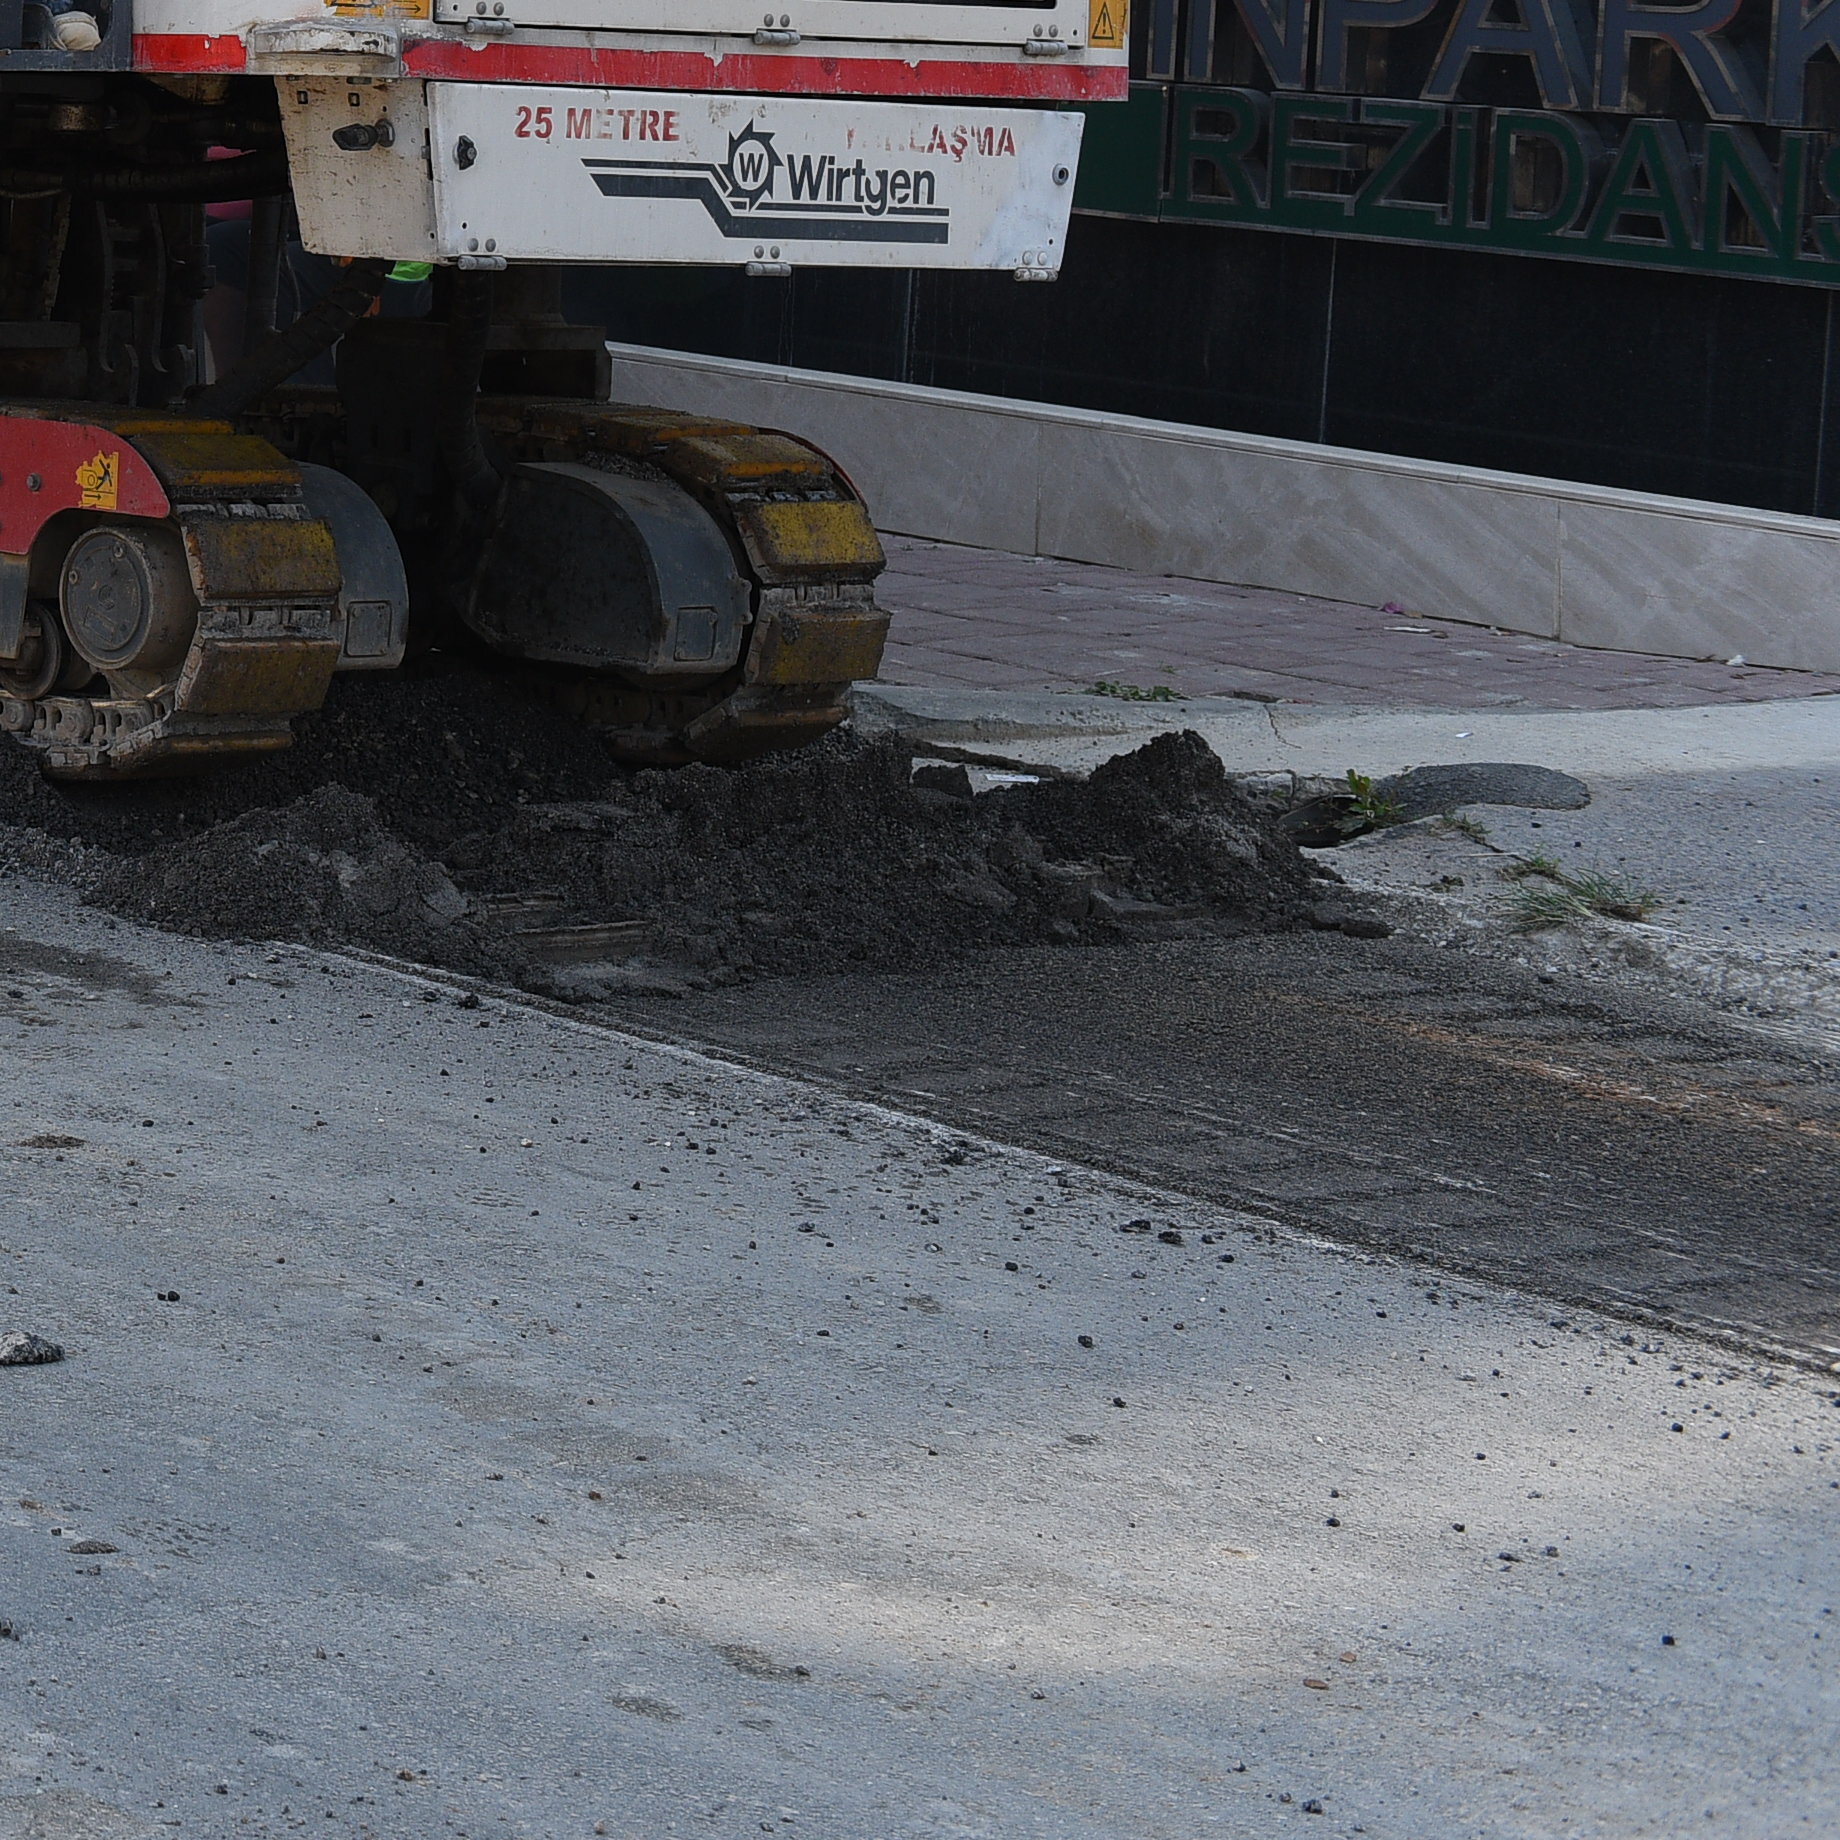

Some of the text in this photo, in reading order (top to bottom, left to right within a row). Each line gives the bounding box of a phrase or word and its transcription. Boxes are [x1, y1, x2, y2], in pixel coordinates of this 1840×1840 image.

[513, 105, 554, 140] 25
[565, 107, 681, 142] METRE
[786, 153, 936, 217] Wirtgen
